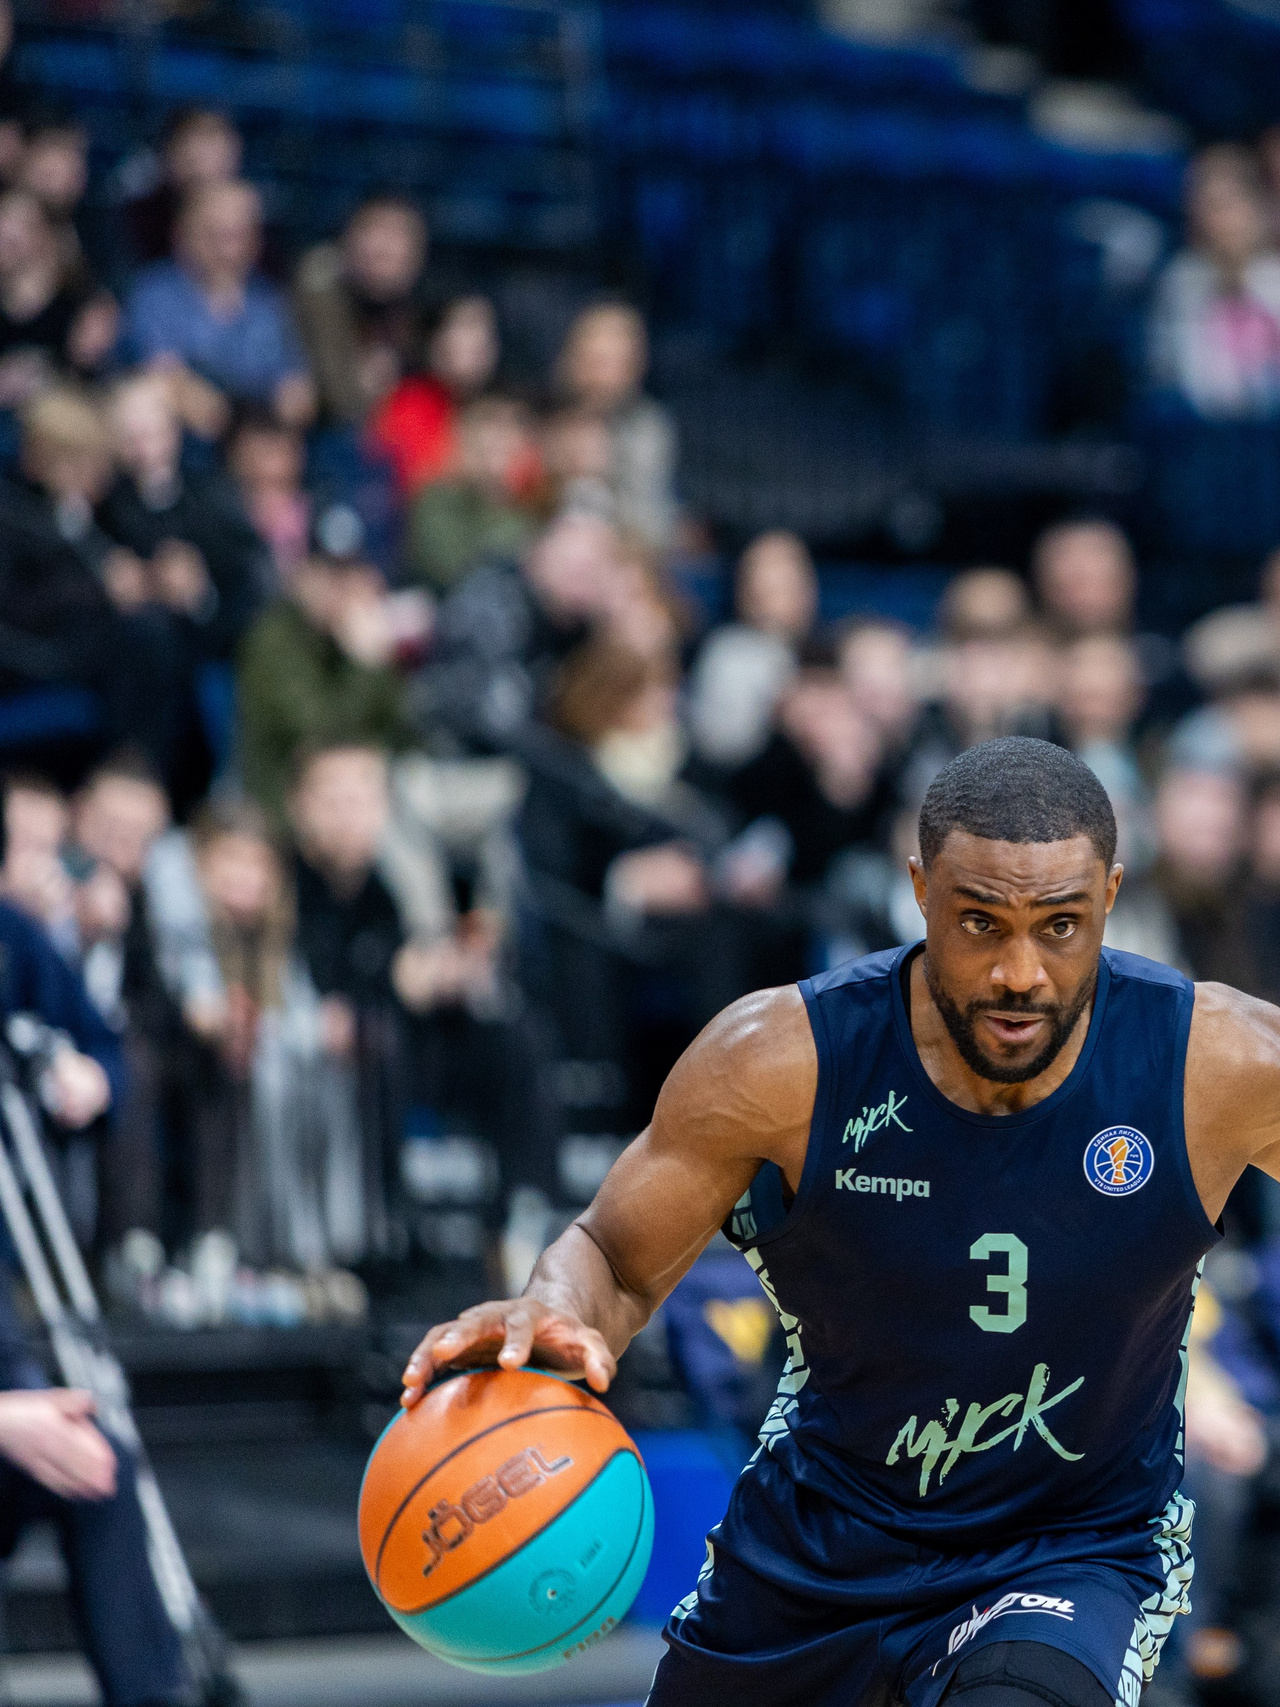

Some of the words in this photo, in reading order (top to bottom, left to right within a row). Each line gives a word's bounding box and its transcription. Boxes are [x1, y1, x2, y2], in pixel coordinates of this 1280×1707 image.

[1093, 1130, 1117, 1147] ЕДИНАЯ
[835, 1168, 930, 1202] Kempa
[1125, 1176, 1143, 1190] LEAGUE
[969, 1232, 1028, 1334] 3
[421, 1446, 574, 1578] JÖGEL
